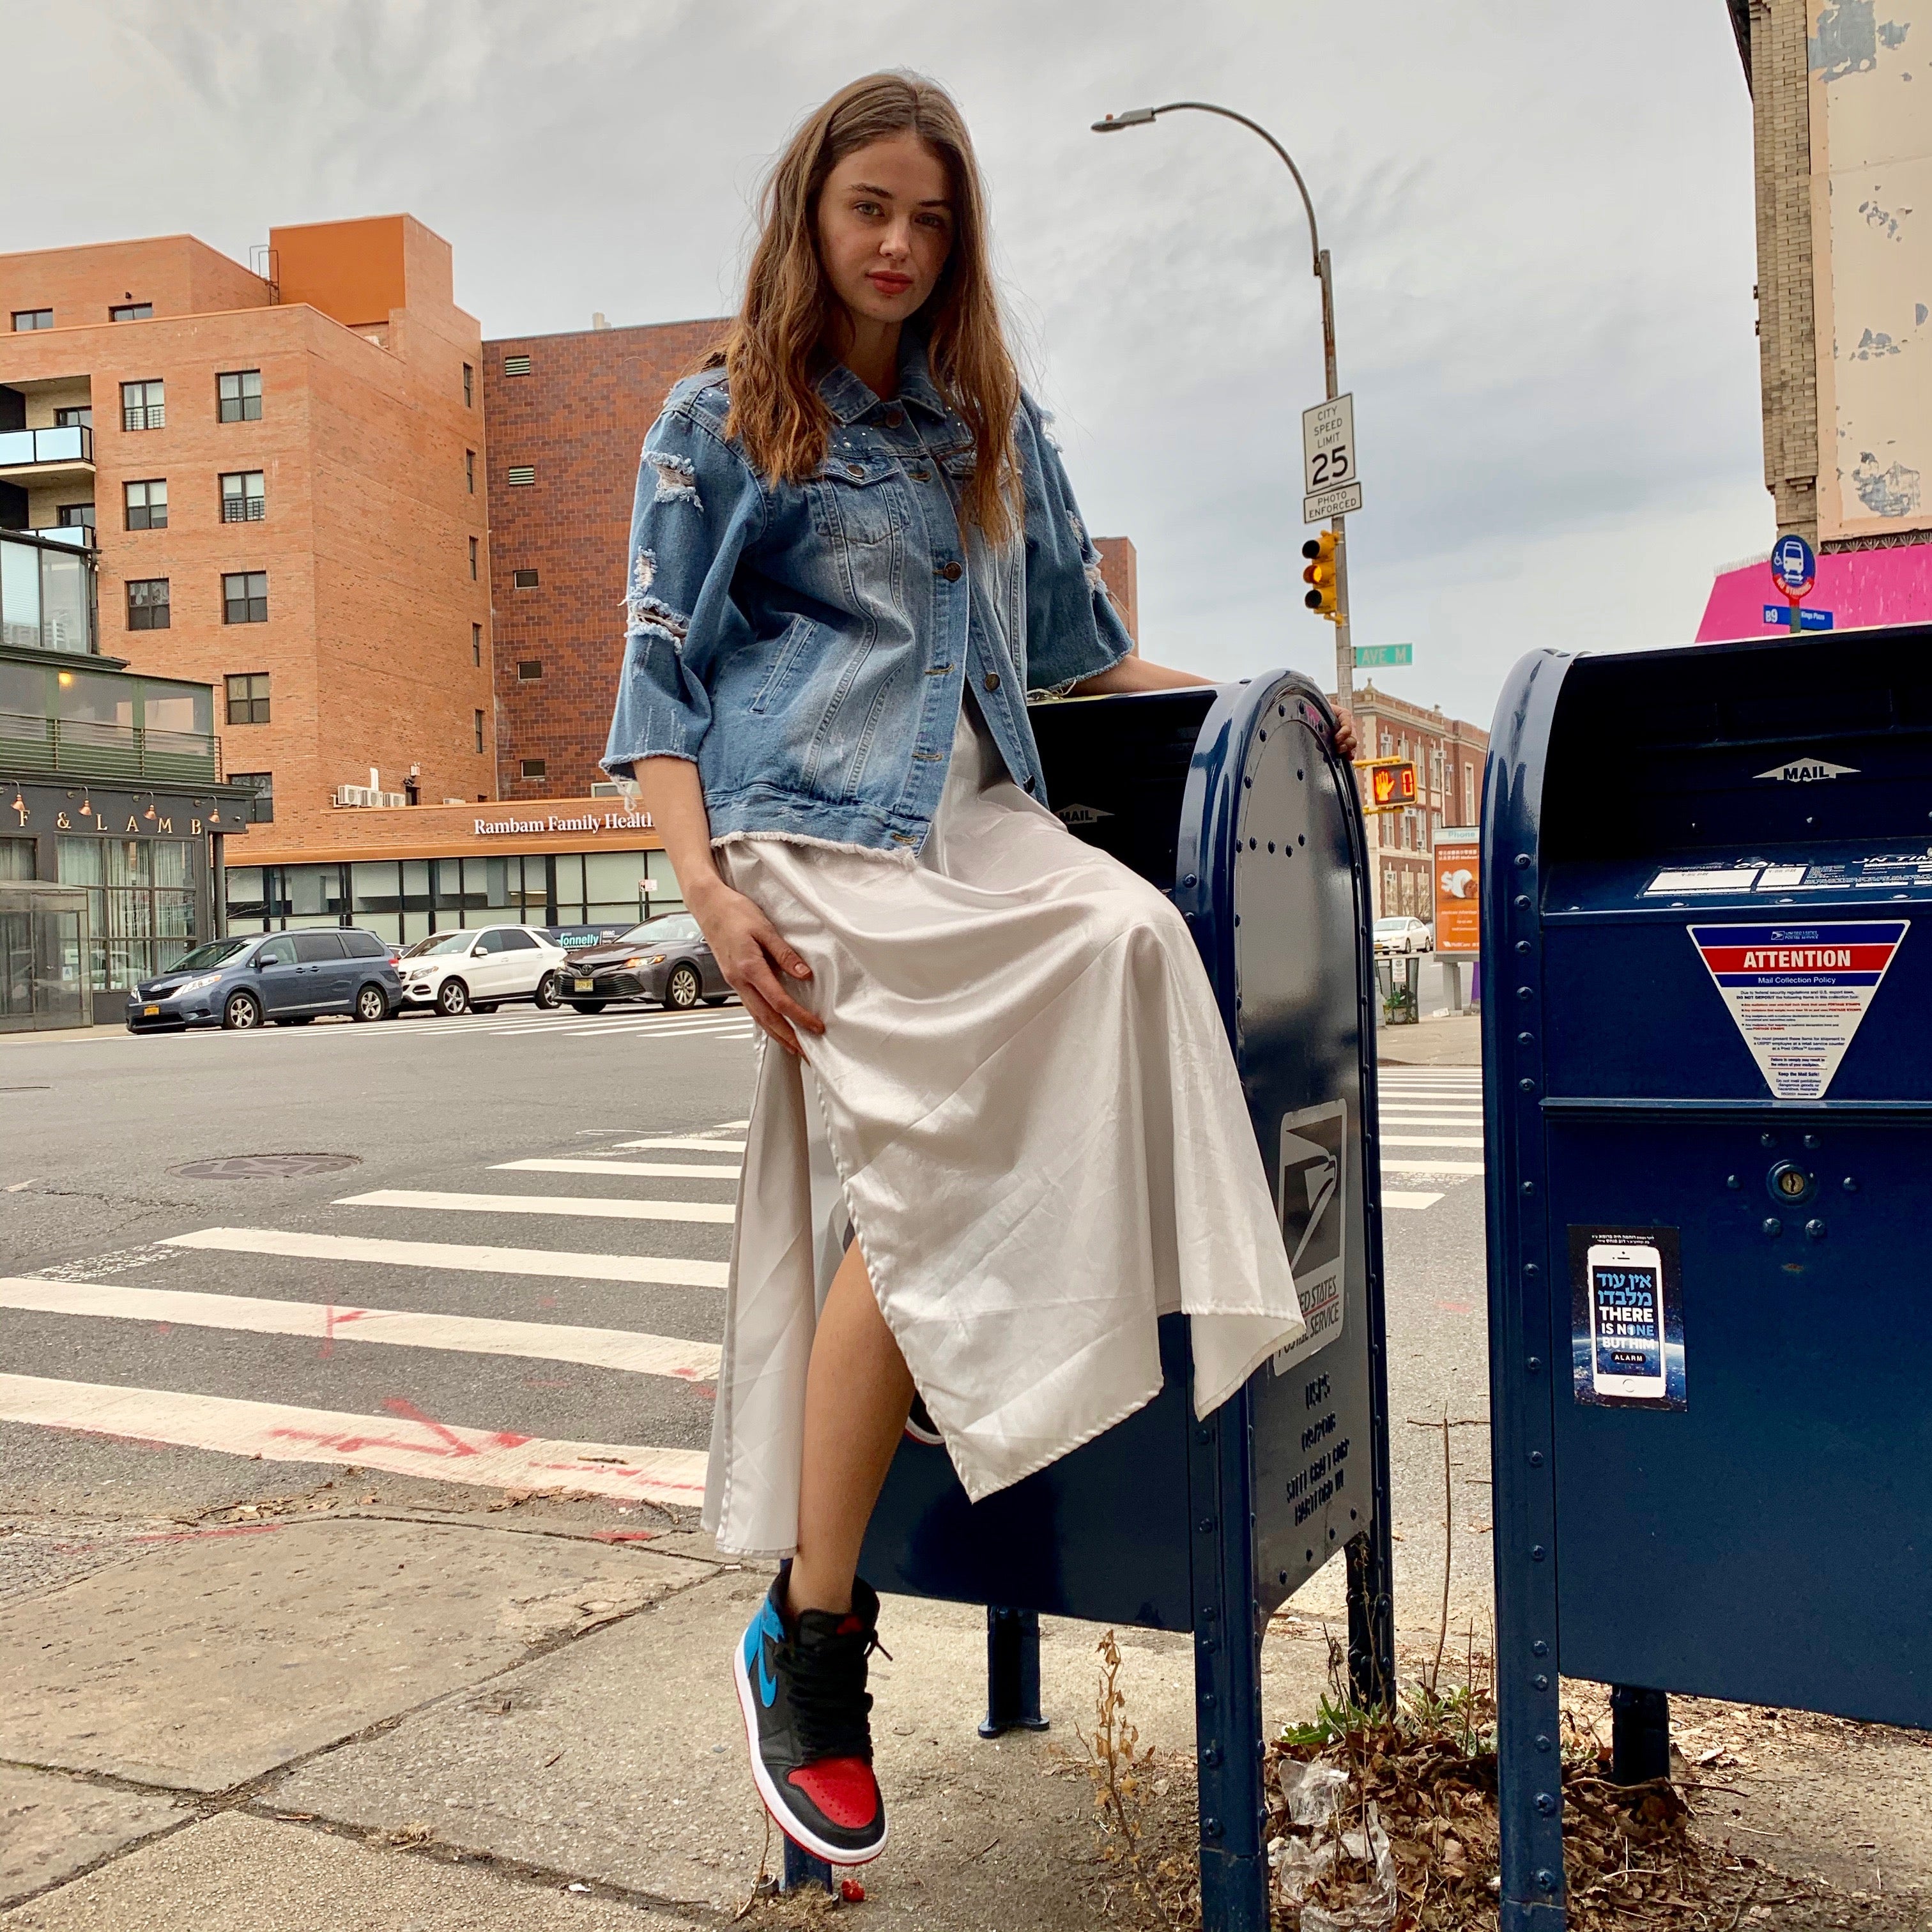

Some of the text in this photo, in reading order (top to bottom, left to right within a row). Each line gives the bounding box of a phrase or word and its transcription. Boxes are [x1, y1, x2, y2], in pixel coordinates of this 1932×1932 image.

[1318, 406, 1338, 421] CITY
[1314, 418, 1342, 436] SPEED
[1318, 432, 1340, 448] LIMIT
[1312, 445, 1348, 486] 25
[1318, 491, 1347, 506] PHOTO
[1310, 498, 1356, 518] ENFORCED
[1766, 609, 1777, 622] B9
[1362, 647, 1406, 664] AVE M
[1783, 766, 1829, 781] MAIL
[474, 818, 544, 834] Rambam
[548, 815, 601, 834] Family
[1059, 810, 1092, 822] MAIL
[1744, 950, 1850, 968] ATTENTION
[1597, 1273, 1652, 1291] אין עוד
[1312, 1275, 1336, 1308] STATES
[1598, 1287, 1652, 1306] מלבדו
[1310, 1301, 1339, 1338] SERVICE
[1599, 1307, 1653, 1322] THERE
[1602, 1323, 1614, 1334] IS
[1602, 1337, 1655, 1350] BUT HIM
